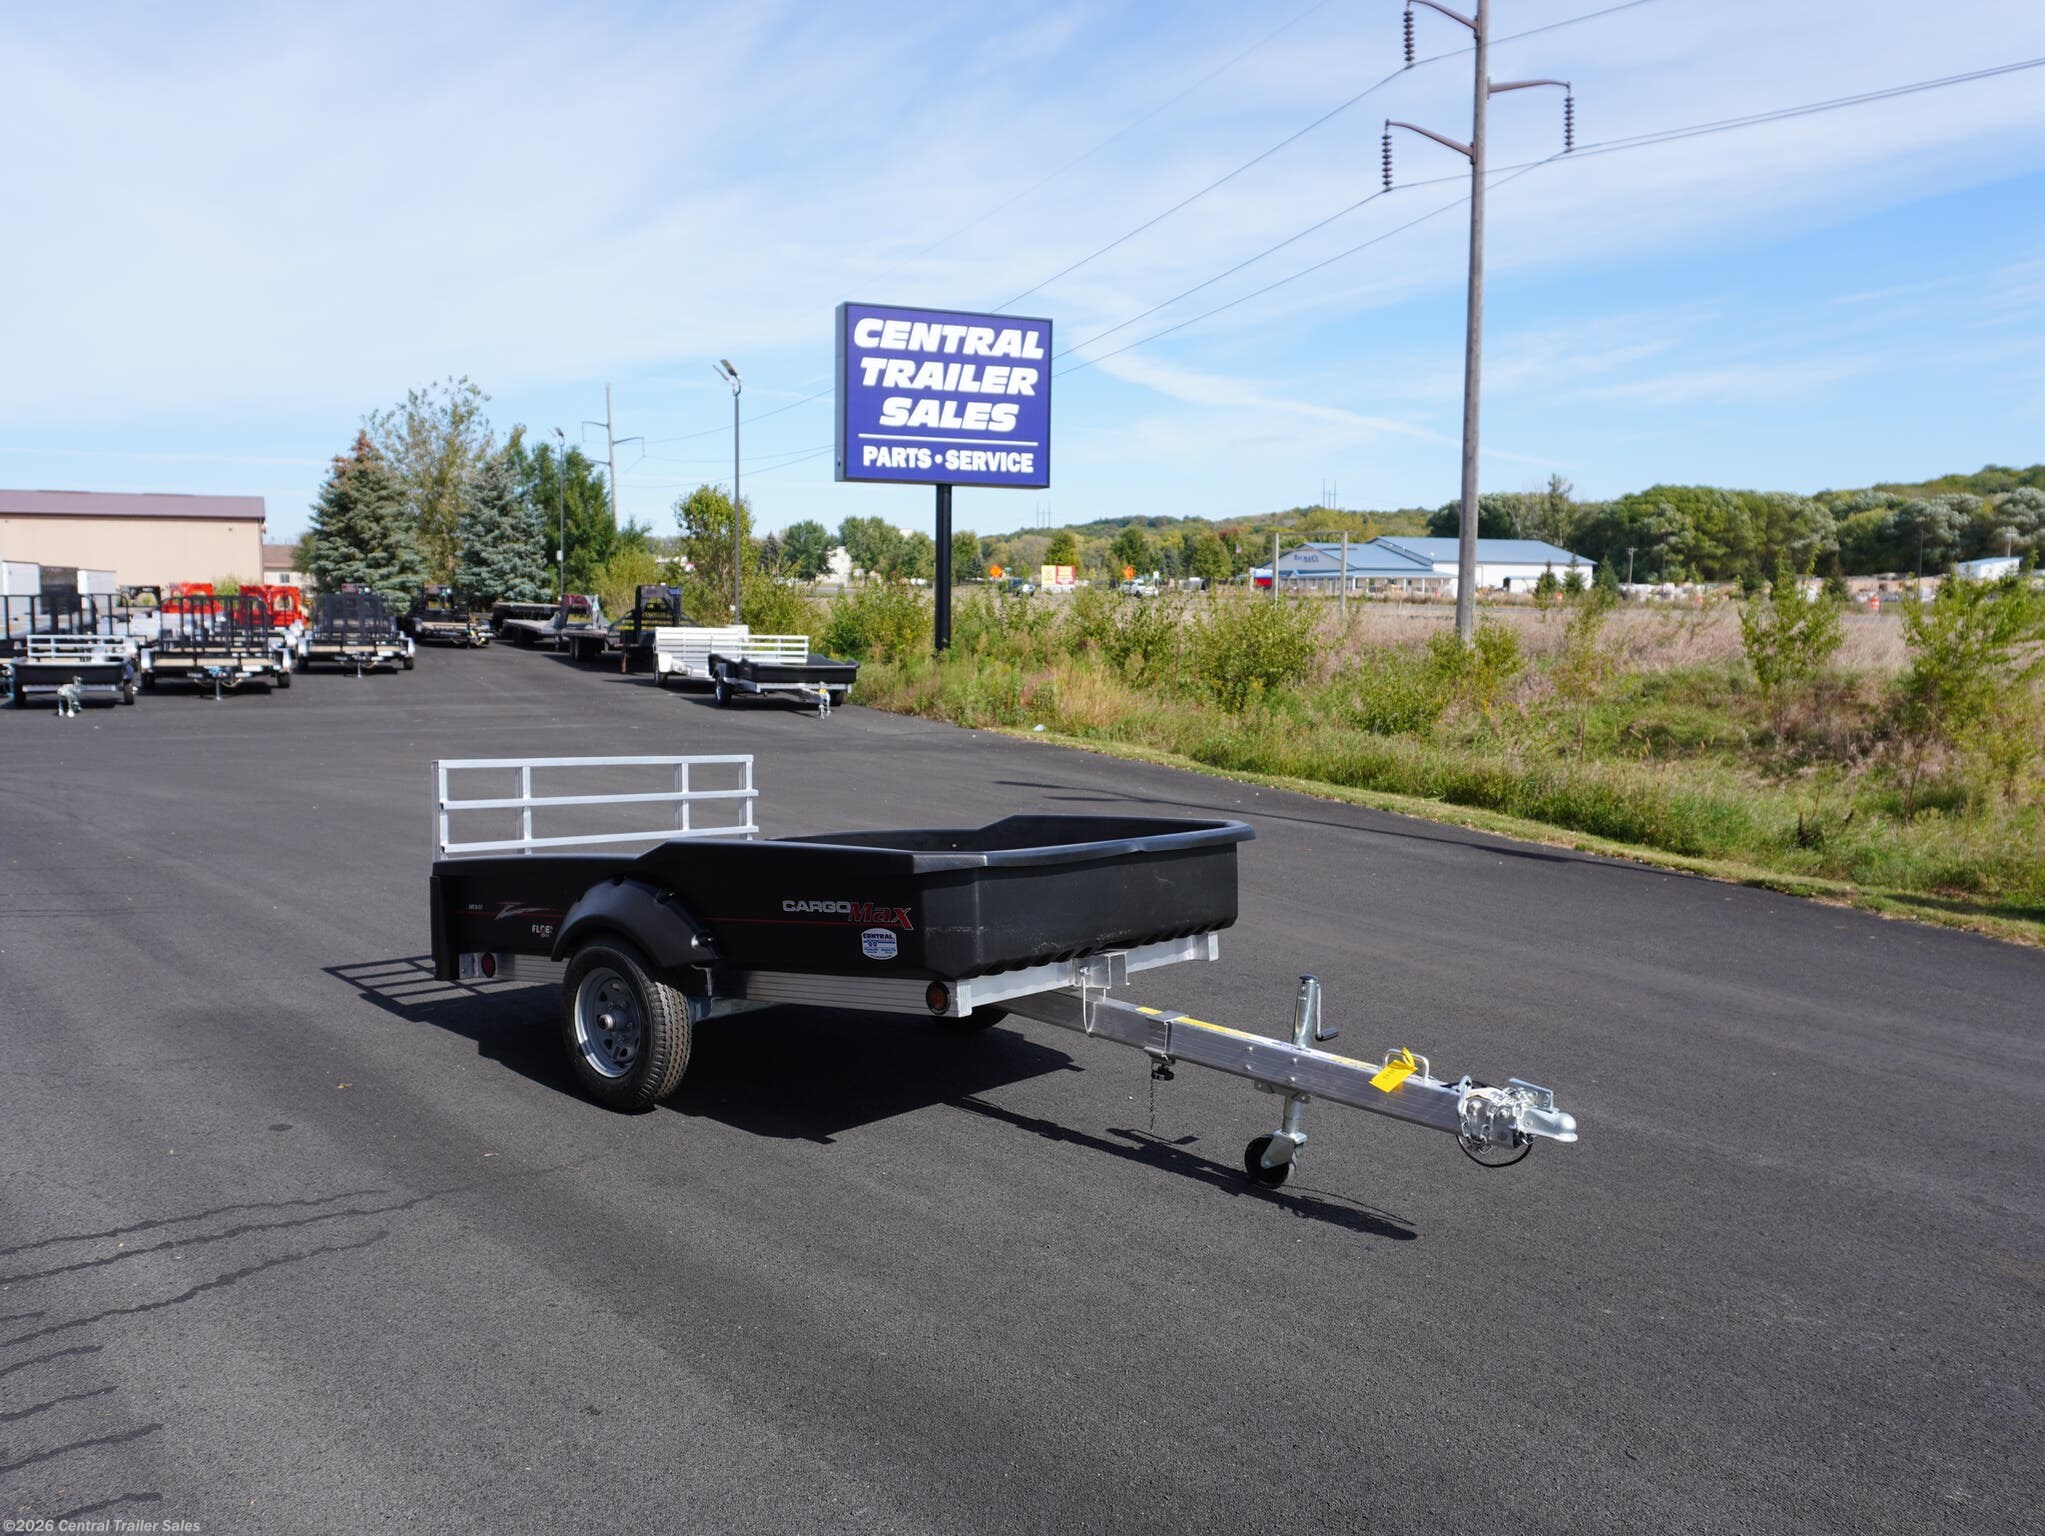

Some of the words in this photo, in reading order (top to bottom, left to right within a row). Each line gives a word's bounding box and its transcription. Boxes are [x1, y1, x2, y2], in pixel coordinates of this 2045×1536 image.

[853, 317, 1044, 360] CENTRAL
[860, 356, 1039, 396] TRAILER
[879, 396, 1020, 433] SALES
[862, 445, 932, 469] PARTS
[944, 449, 1034, 474] SERVICE
